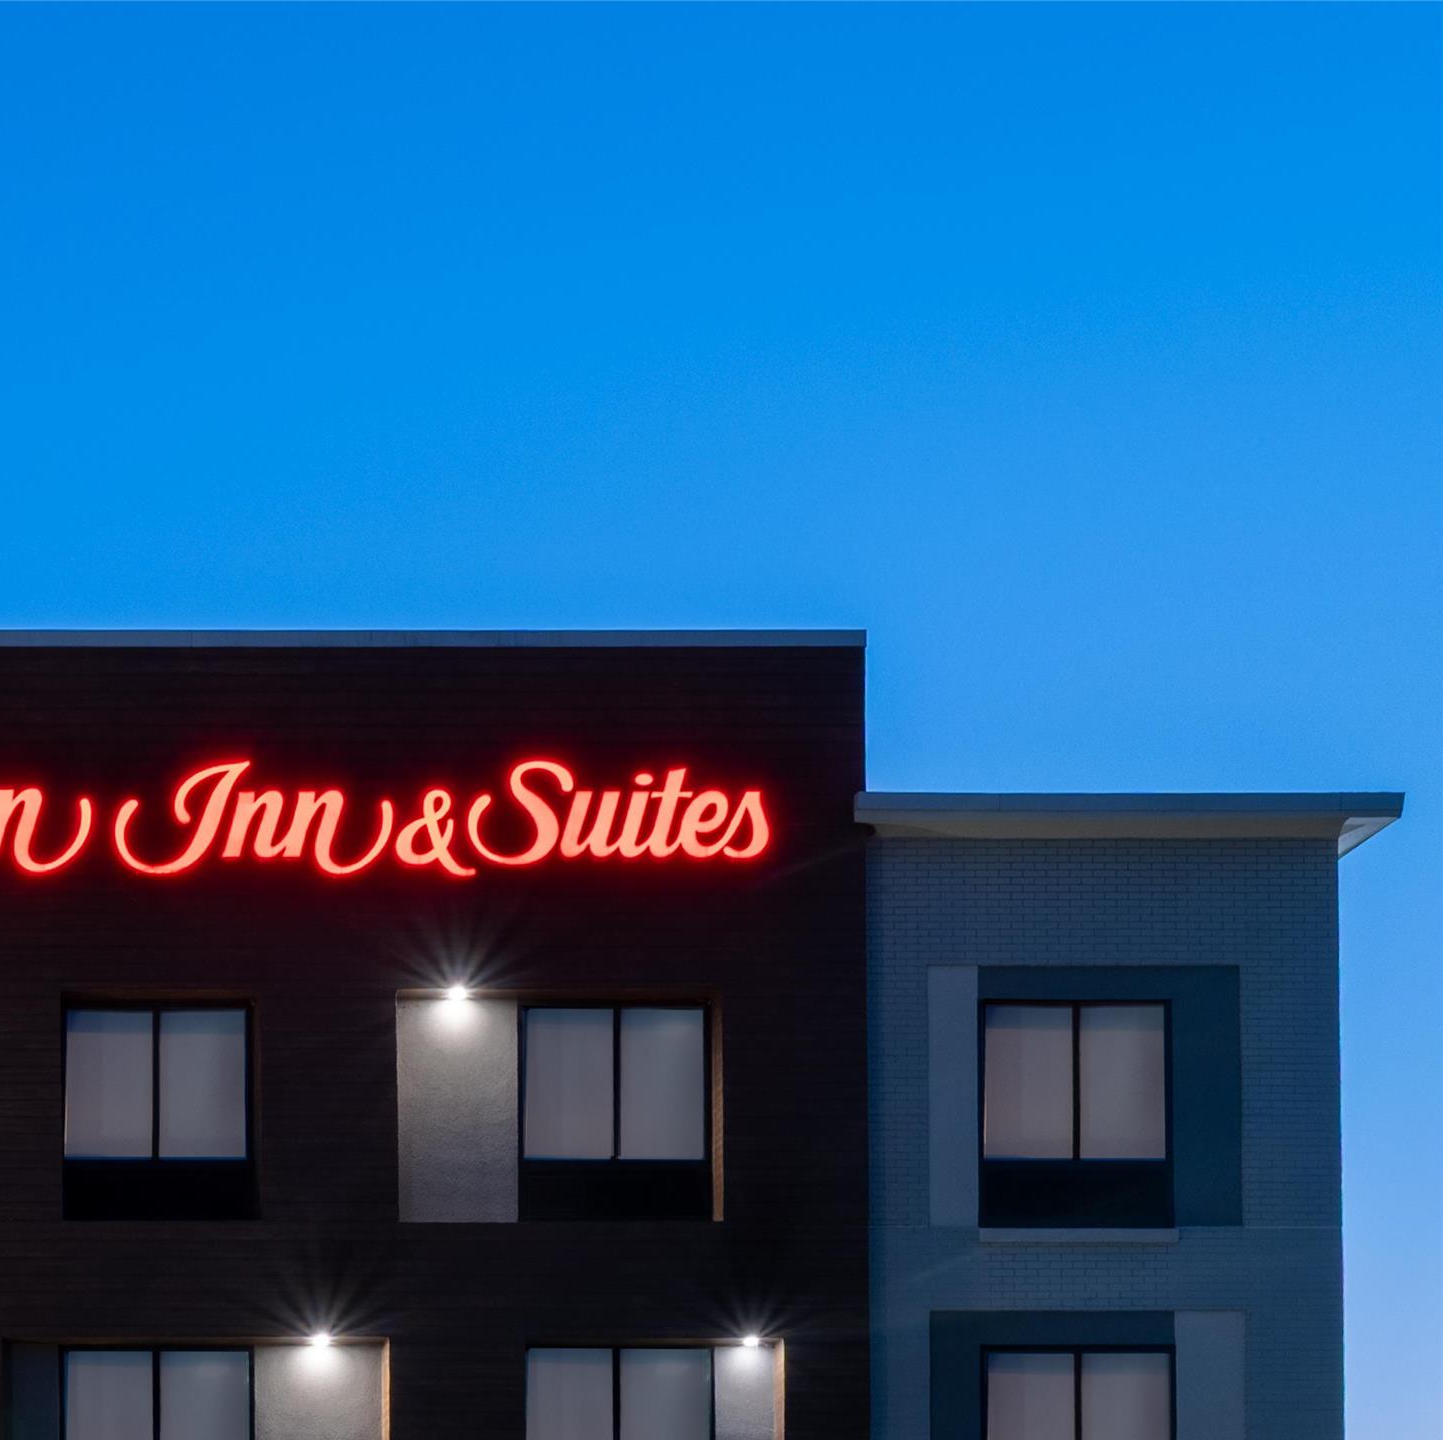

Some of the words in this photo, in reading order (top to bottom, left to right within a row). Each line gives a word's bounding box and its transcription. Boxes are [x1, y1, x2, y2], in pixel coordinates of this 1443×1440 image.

[114, 760, 395, 876] Inn
[394, 788, 477, 877] &
[467, 759, 771, 866] Suites
